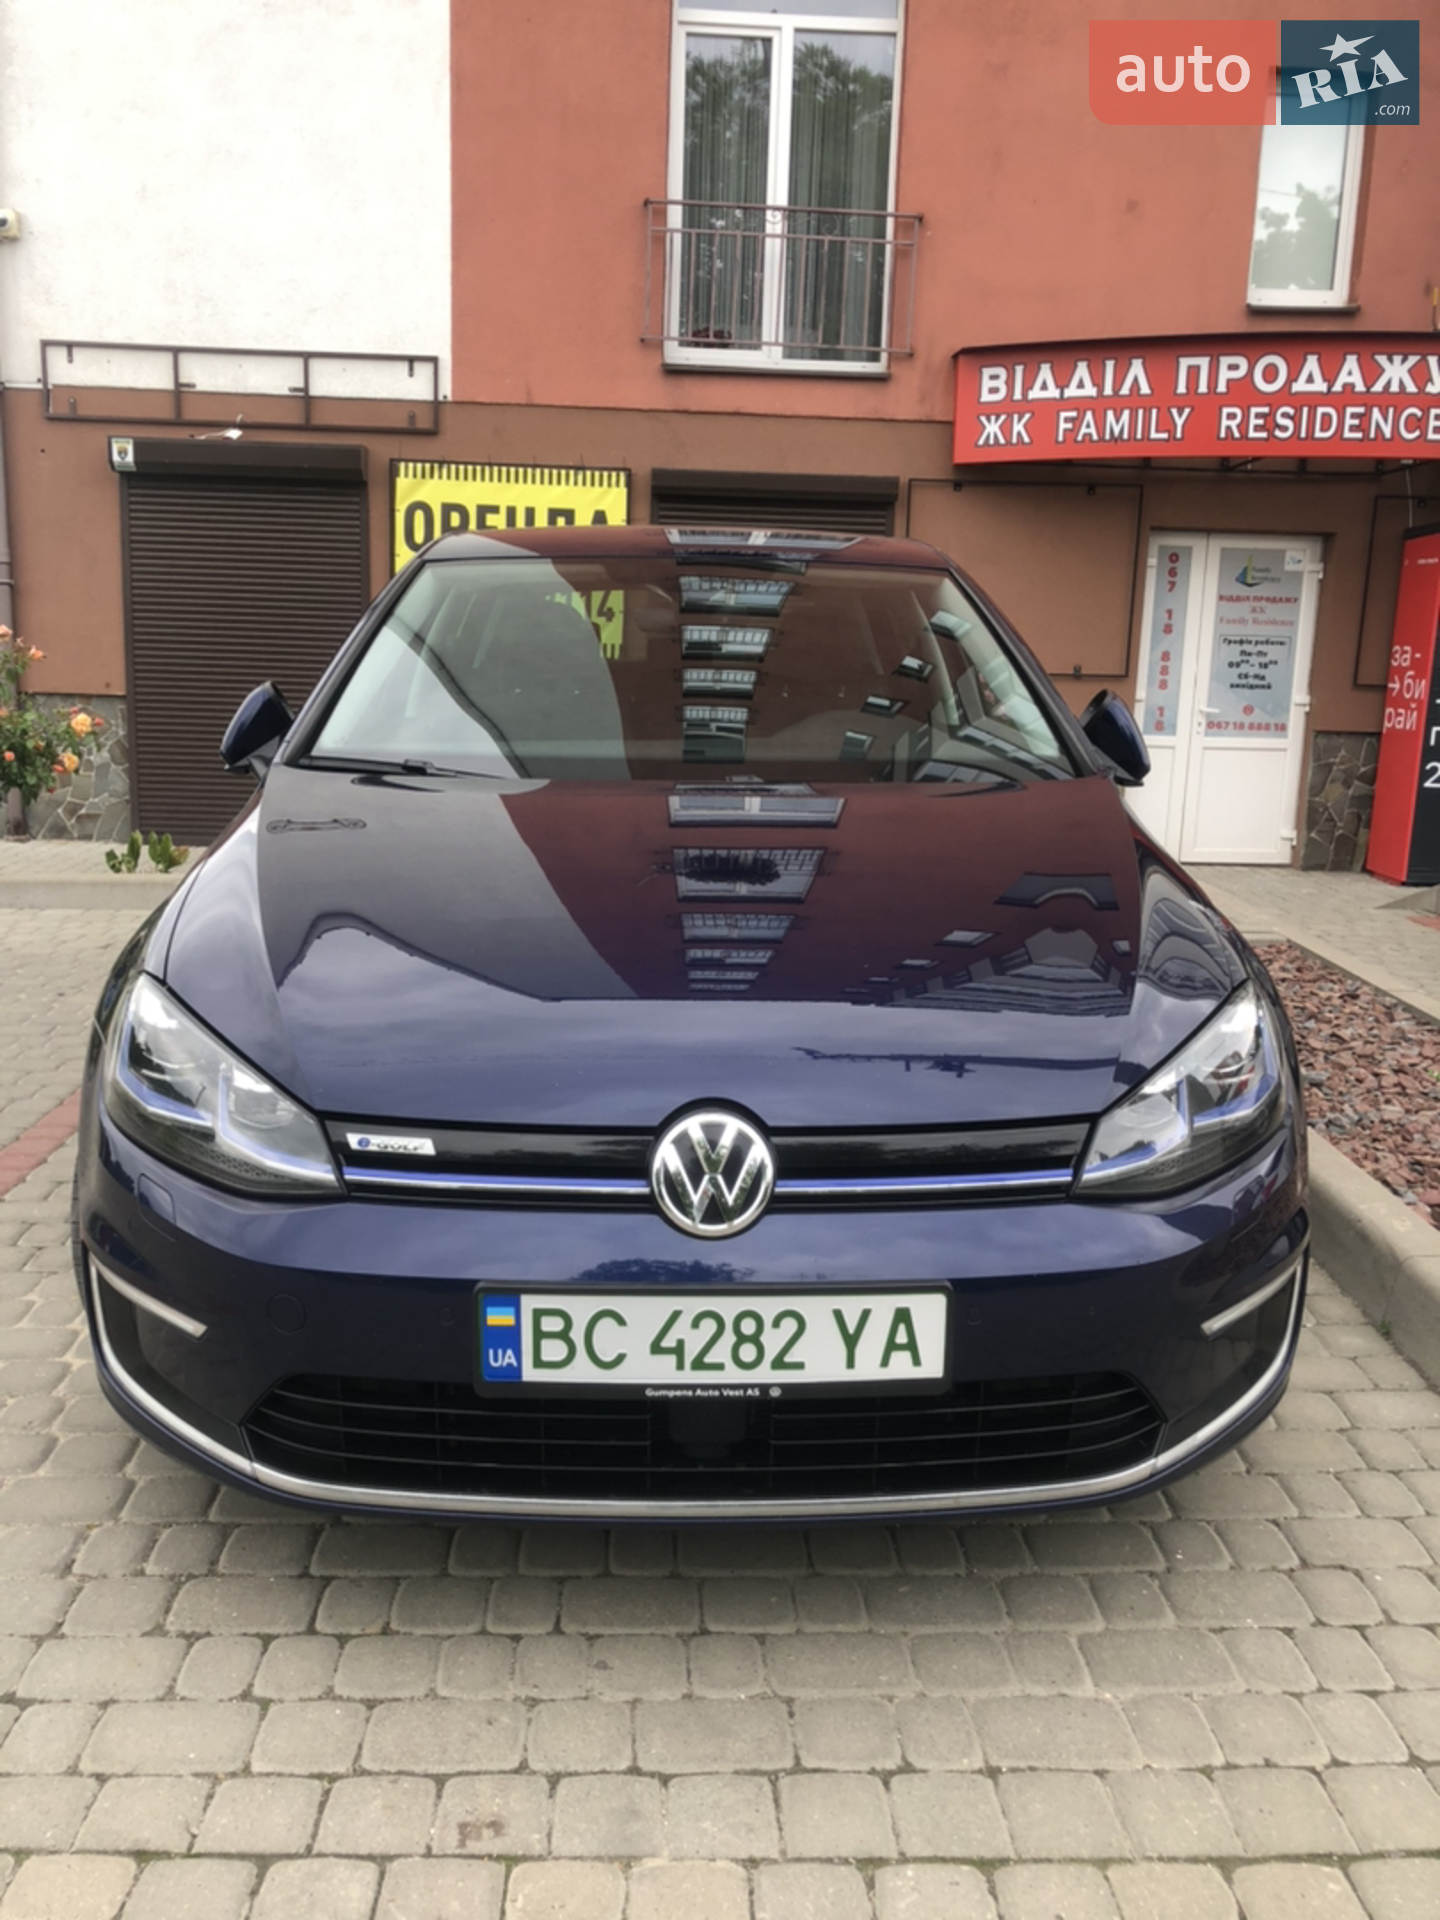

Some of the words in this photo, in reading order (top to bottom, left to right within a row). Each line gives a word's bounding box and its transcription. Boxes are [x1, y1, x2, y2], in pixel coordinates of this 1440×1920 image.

[979, 358, 1152, 403] ВІДДІЛ
[975, 413, 1033, 447] ЖК
[1056, 407, 1192, 443] FAMILY
[1218, 406, 1440, 440] RESIDENCE
[1383, 702, 1418, 734] рай
[531, 1307, 628, 1370] BC
[648, 1308, 807, 1371] 4282
[831, 1306, 922, 1370] YA
[488, 1348, 518, 1368] UA
[644, 1387, 693, 1398] Gumpens
[695, 1387, 720, 1397] Auto
[721, 1387, 744, 1397] Vest
[746, 1387, 760, 1397] AS
